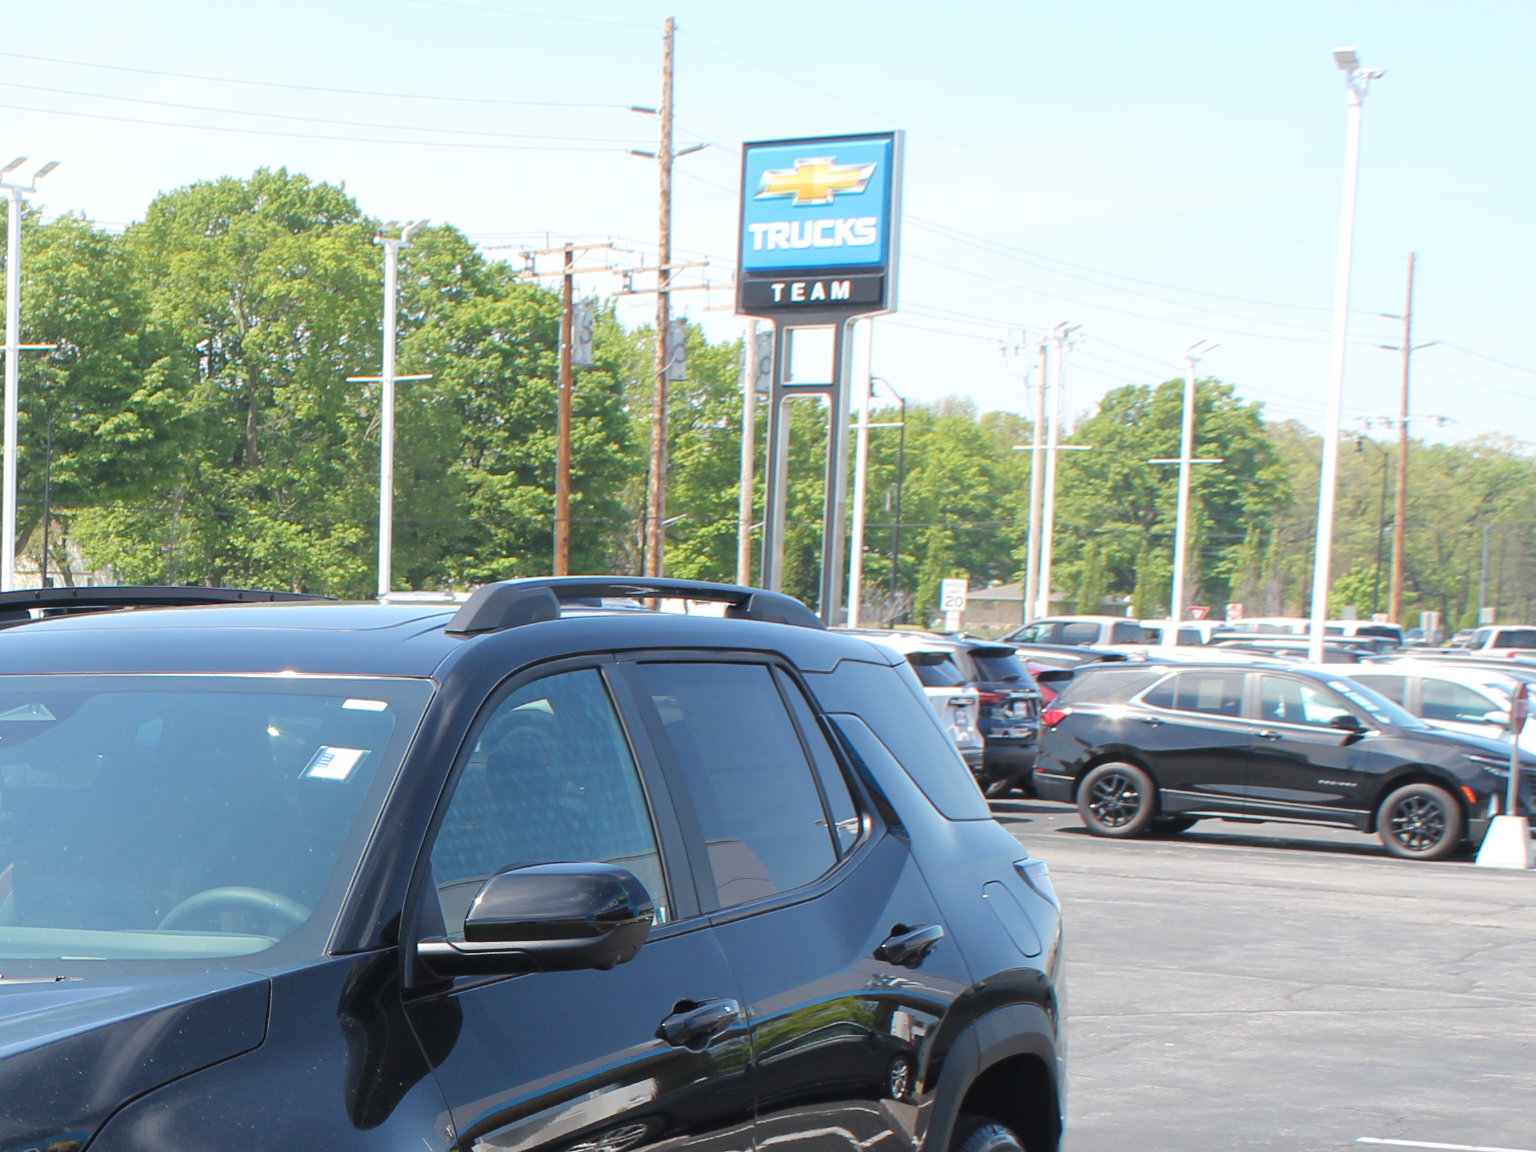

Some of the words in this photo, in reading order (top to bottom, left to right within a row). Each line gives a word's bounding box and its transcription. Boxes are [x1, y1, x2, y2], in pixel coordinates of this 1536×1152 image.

[748, 216, 877, 251] TRUCKS
[771, 280, 852, 302] TEAM
[945, 595, 964, 607] 20
